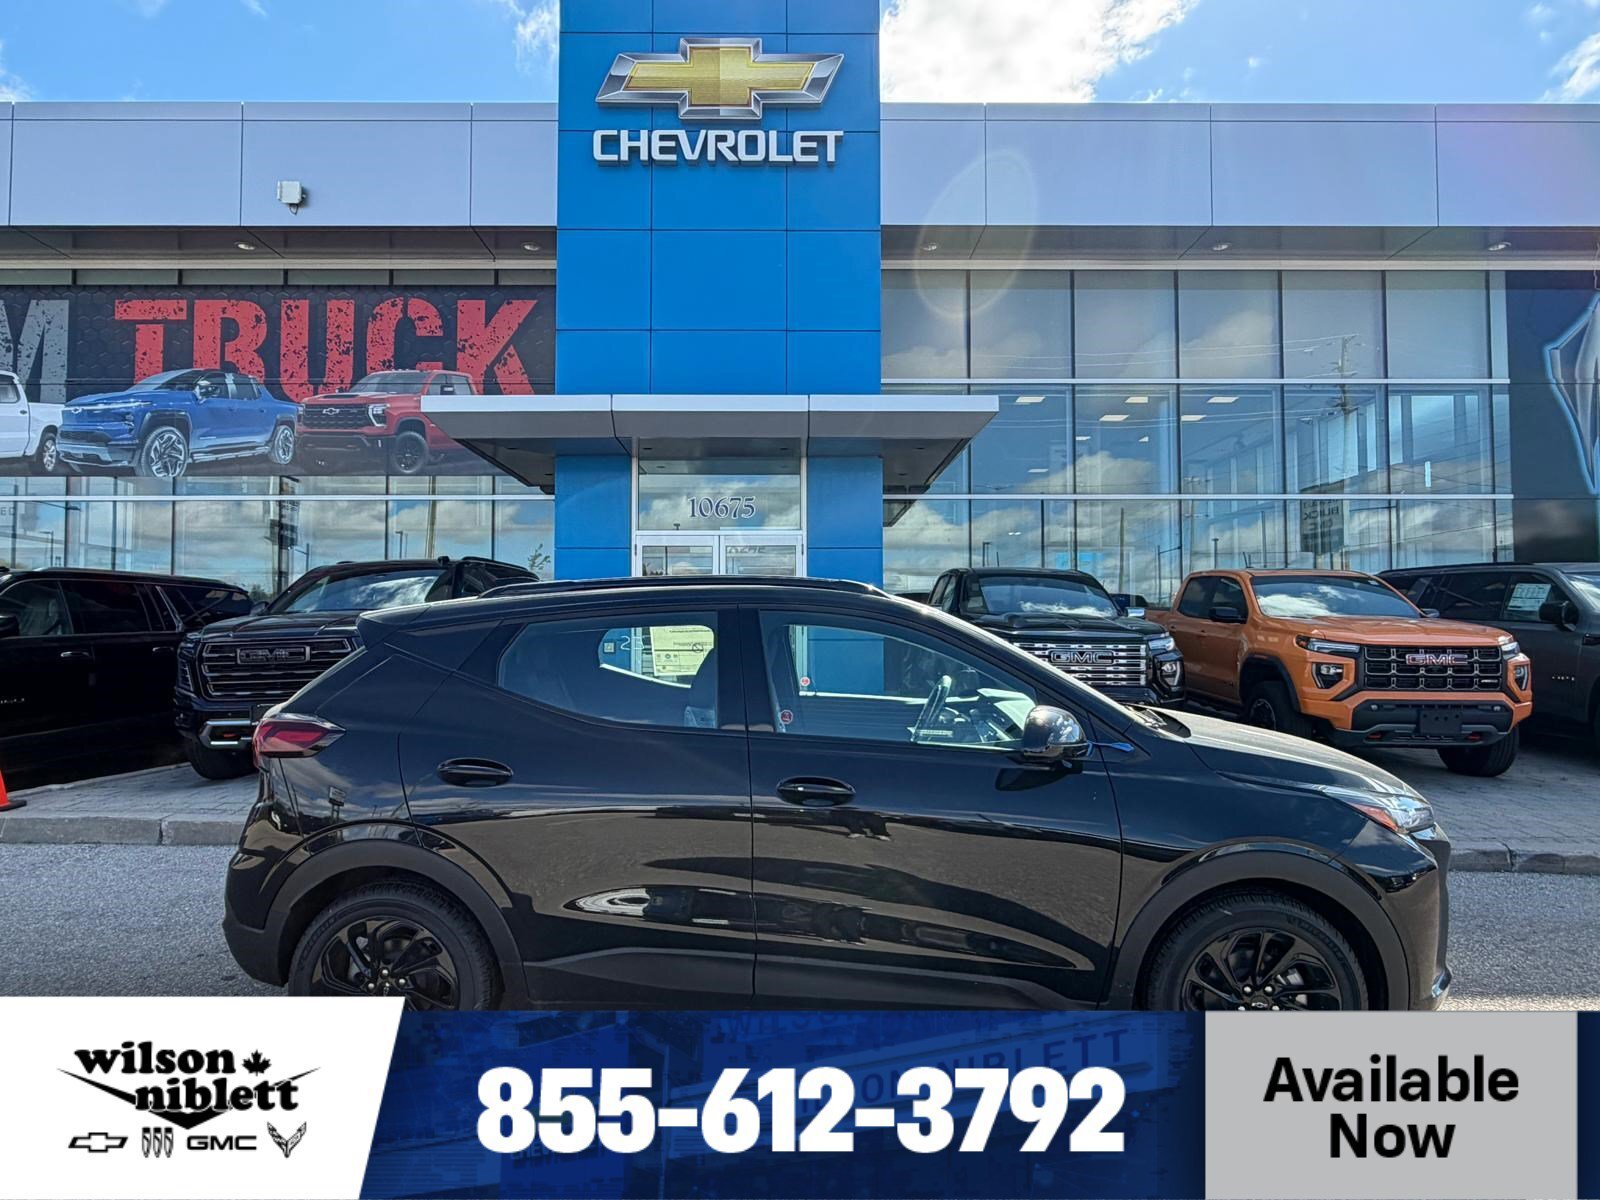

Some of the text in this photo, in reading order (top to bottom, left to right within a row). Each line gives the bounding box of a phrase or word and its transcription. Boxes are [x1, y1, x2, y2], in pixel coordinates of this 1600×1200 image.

[592, 129, 844, 162] CHEVROLET
[114, 297, 537, 399] TRUCK
[688, 496, 756, 519] 10675
[1050, 650, 1113, 664] GMC
[1405, 653, 1468, 666] GMC
